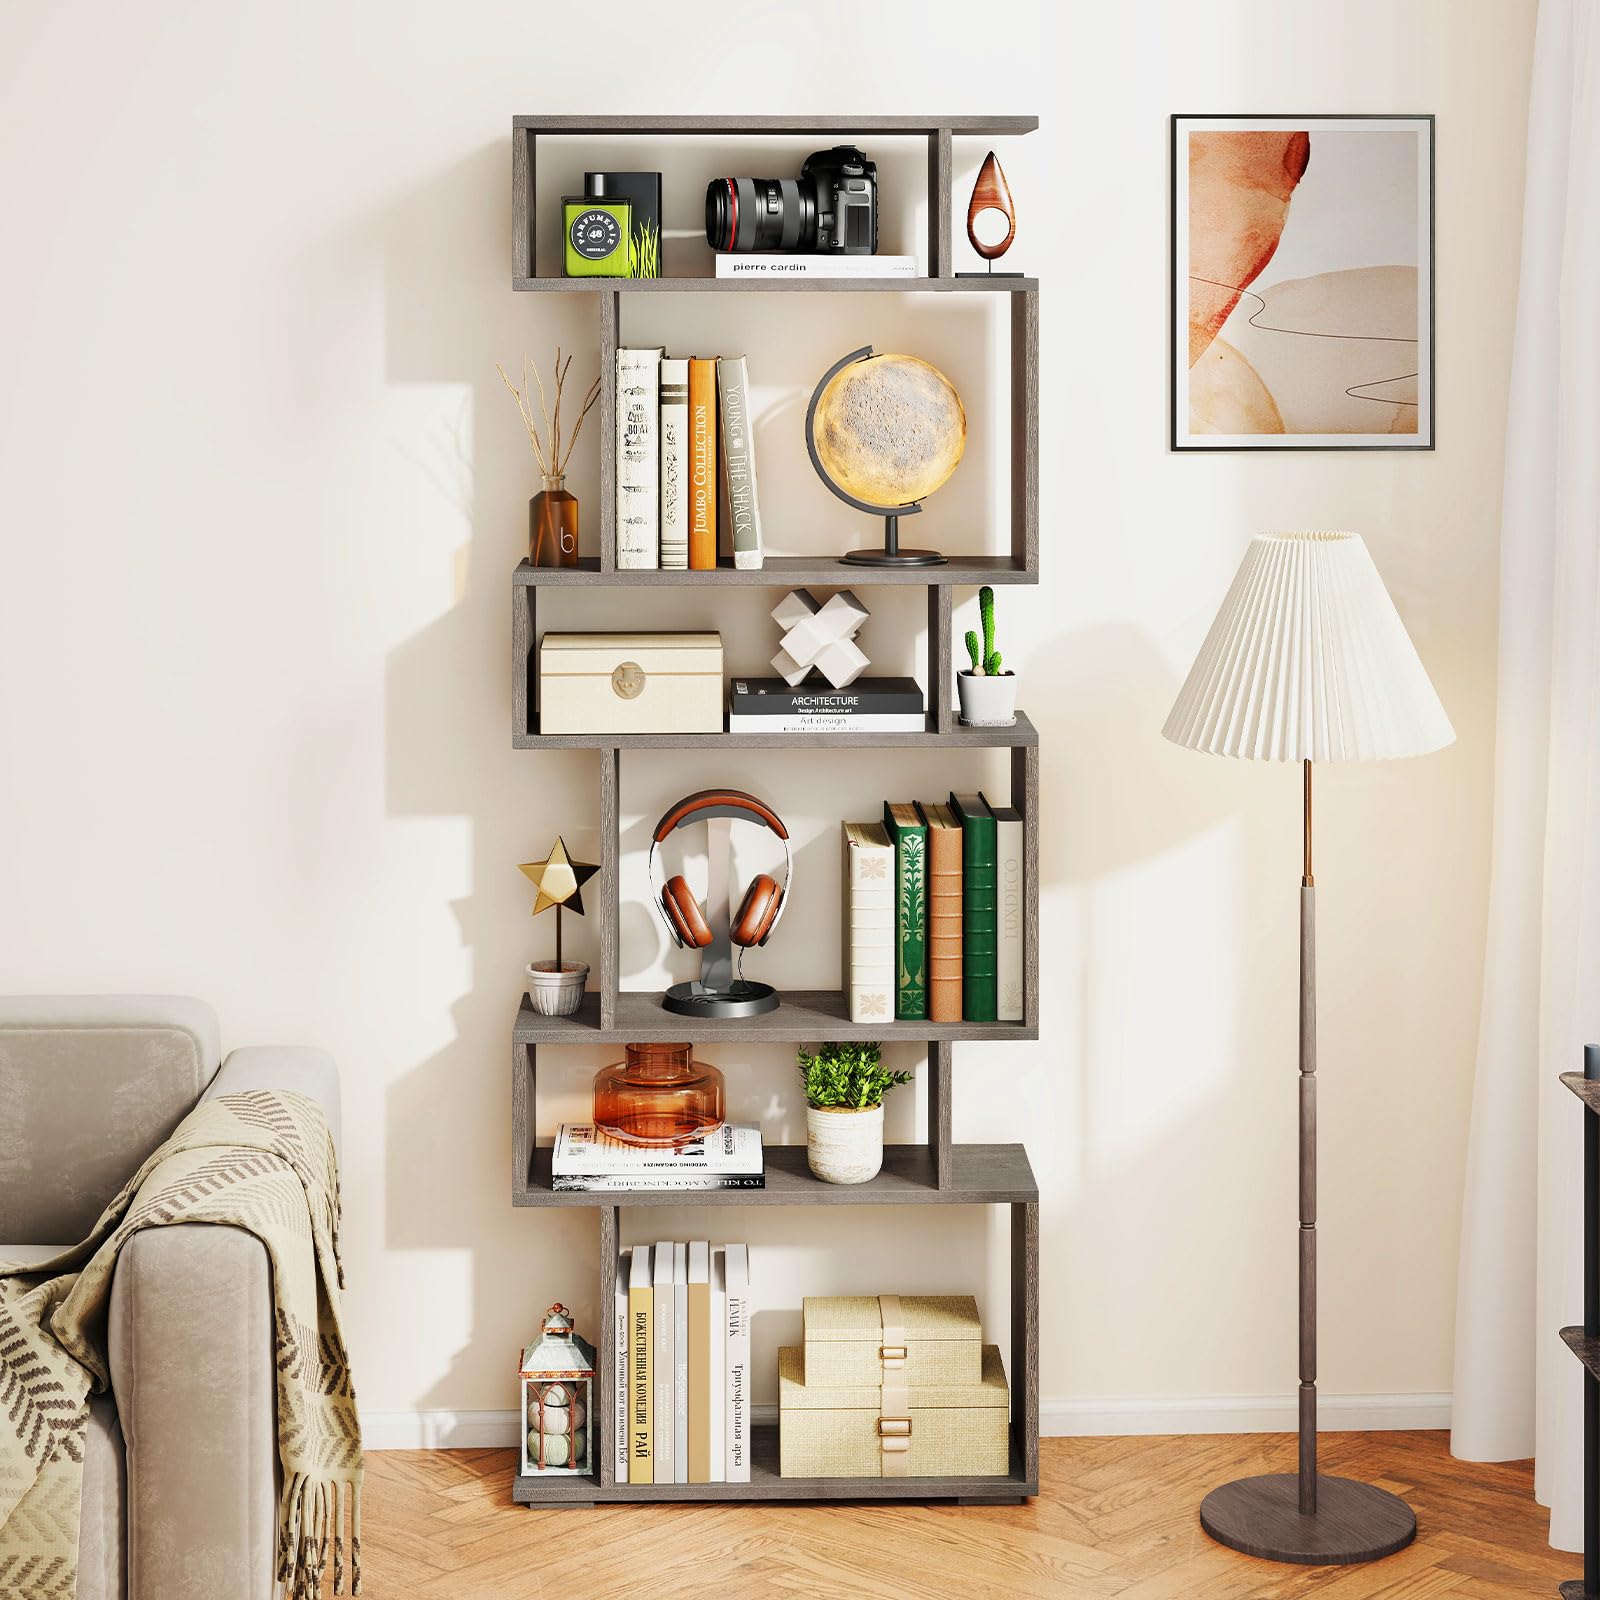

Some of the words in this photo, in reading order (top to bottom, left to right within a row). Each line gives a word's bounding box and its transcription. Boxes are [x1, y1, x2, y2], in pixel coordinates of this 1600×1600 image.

[576, 215, 616, 245] PARFUMERIE
[589, 230, 603, 239] 48
[733, 263, 767, 272] pierre
[771, 263, 806, 271] cardin
[726, 384, 743, 437] YOUNG
[694, 405, 707, 486] COLLECTION
[730, 452, 748, 481] THE
[694, 490, 709, 534] JUMBO
[732, 485, 753, 534] SHACK
[792, 697, 858, 705] ARCHITECTURE
[816, 717, 847, 725] design
[636, 1312, 647, 1380] БОЖЕСТВЕННАЯ
[618, 1351, 627, 1388] Уличный
[635, 1383, 647, 1424] КОМЕДИЯ
[732, 1364, 744, 1440] Триумфальная
[618, 1447, 627, 1464] Боб
[636, 1432, 651, 1457] РАЙ
[732, 1443, 743, 1467] арка
